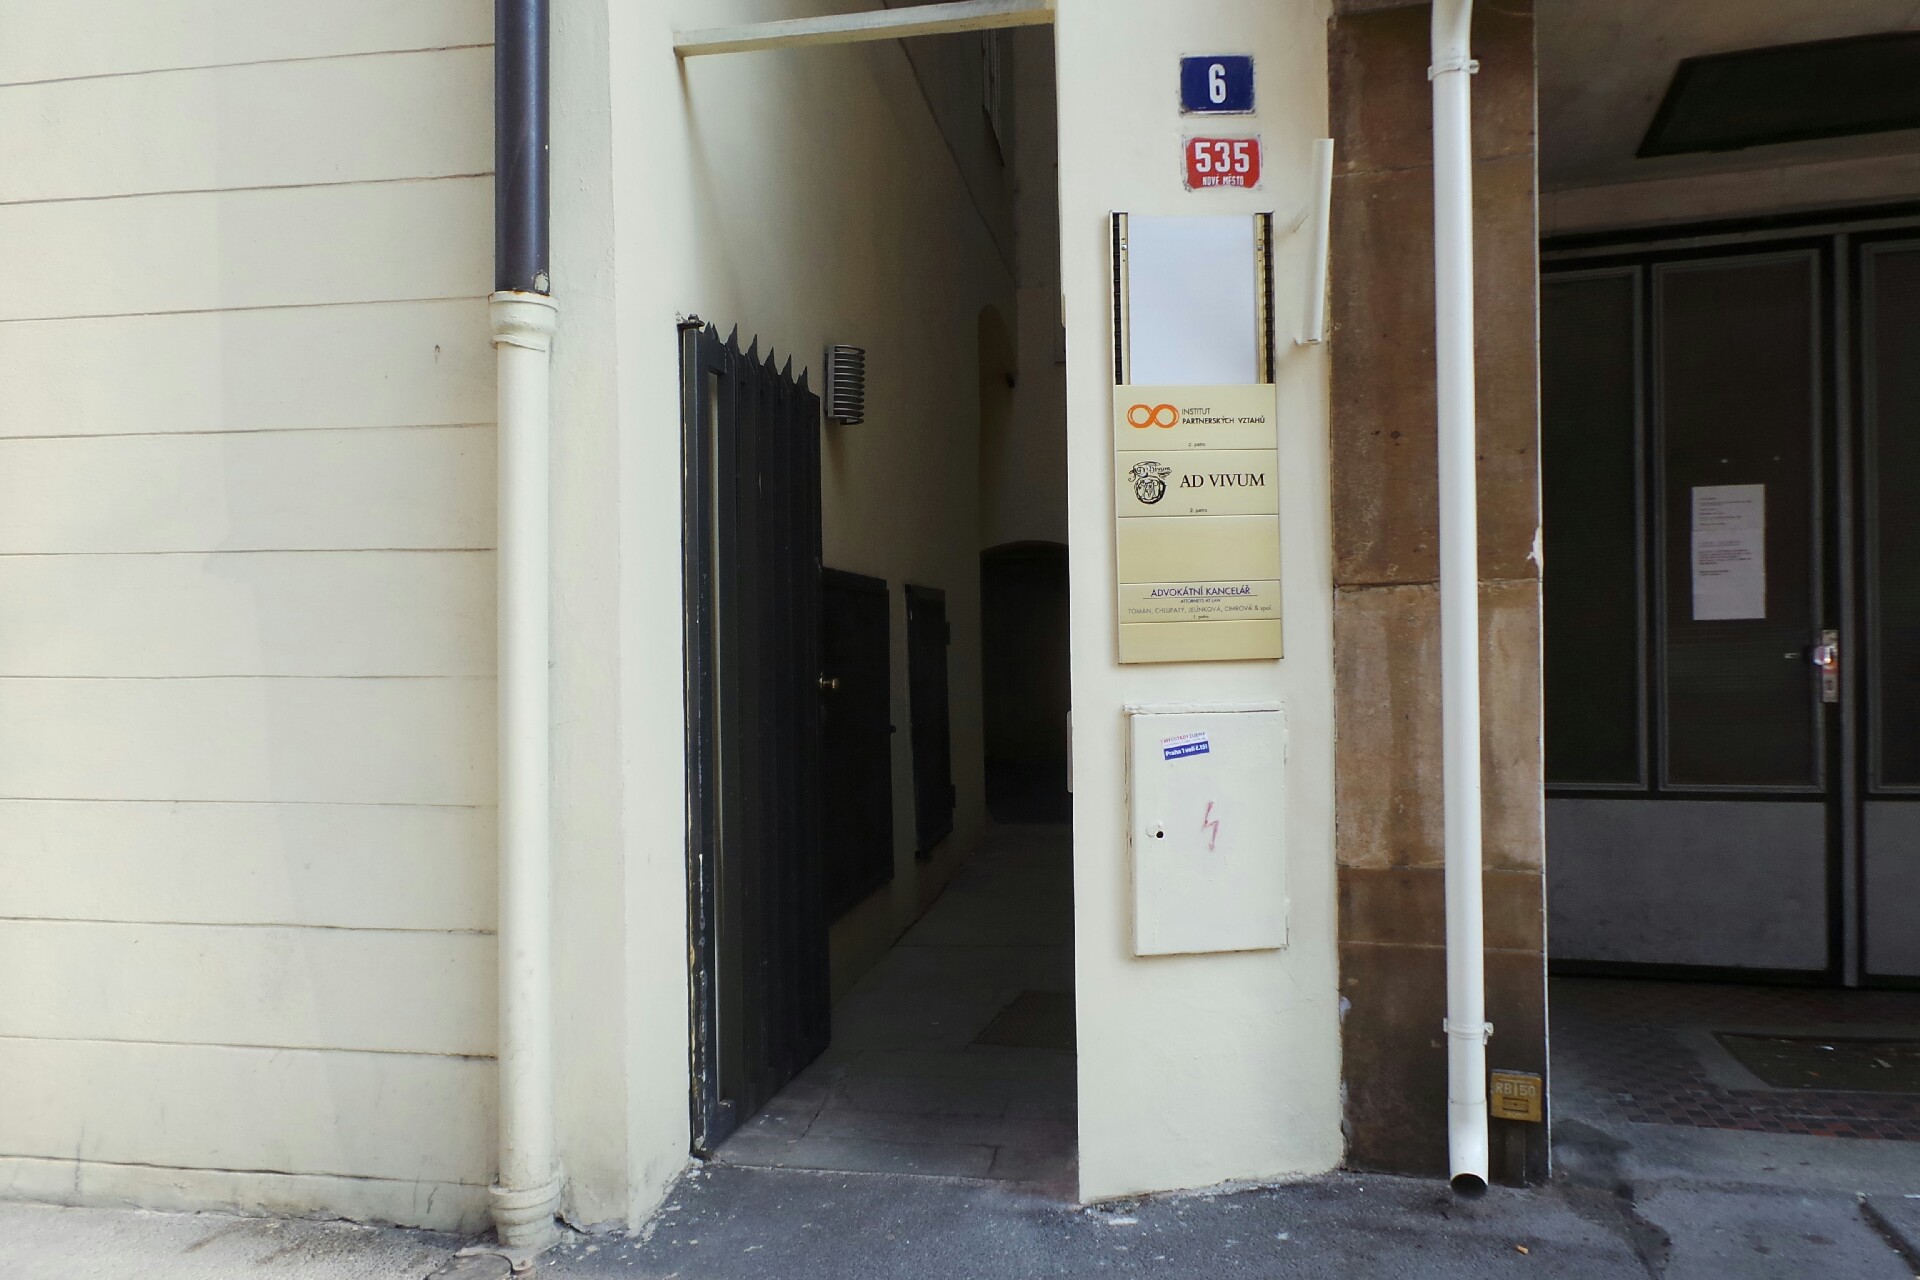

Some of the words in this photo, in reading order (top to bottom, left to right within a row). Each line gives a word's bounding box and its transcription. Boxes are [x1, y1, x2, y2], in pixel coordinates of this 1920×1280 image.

[1208, 63, 1227, 104] 6
[1195, 142, 1249, 173] 535
[1182, 416, 1235, 424] PARTNERSKÝCH
[1238, 415, 1265, 424] VZTAHŮ
[1180, 474, 1204, 488] AD
[1208, 473, 1265, 487] VIVUM
[1151, 586, 1203, 597] ADVOKÁTNÍ
[1206, 585, 1250, 595] KANCELÁŘ
[1165, 748, 1181, 756] Praha
